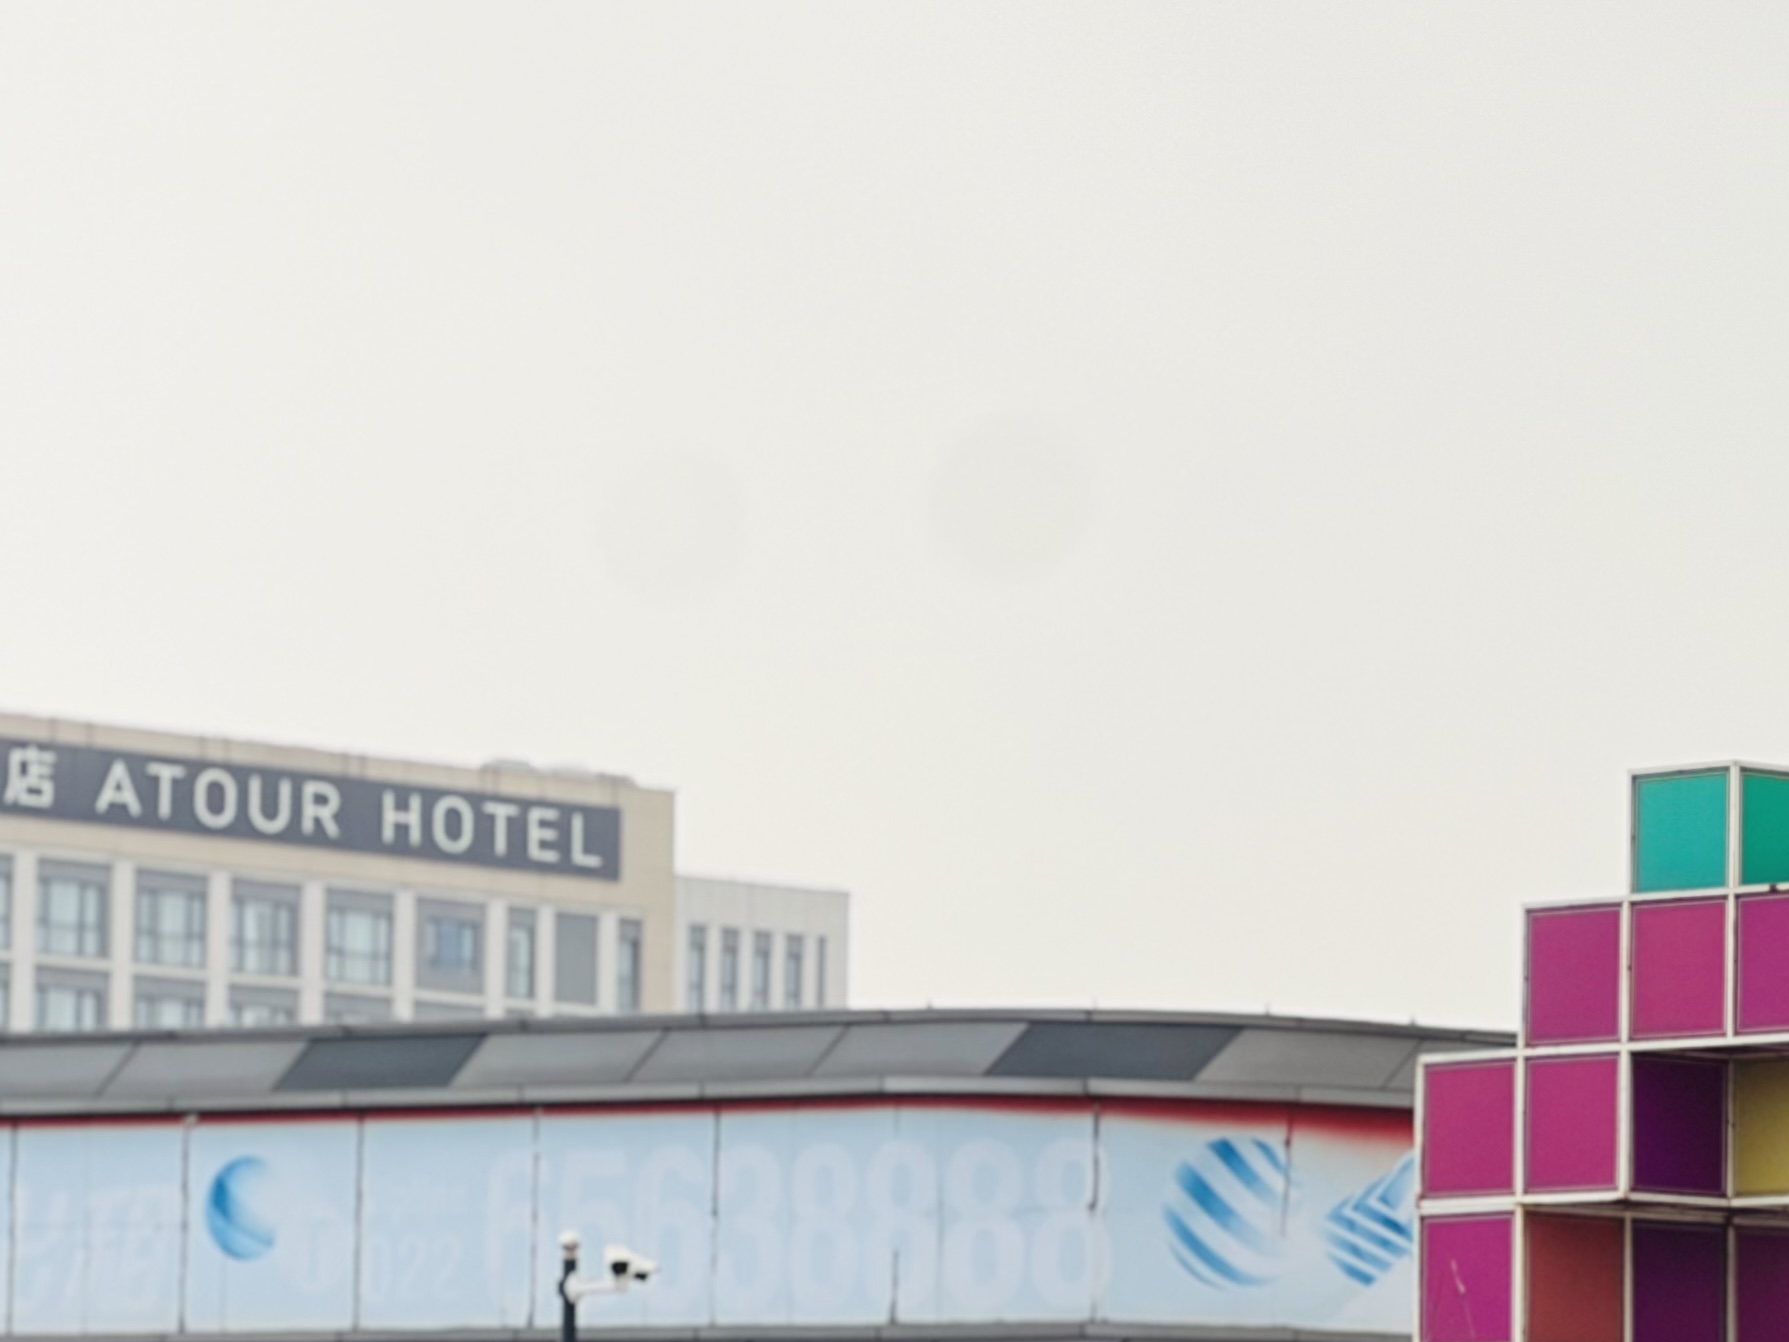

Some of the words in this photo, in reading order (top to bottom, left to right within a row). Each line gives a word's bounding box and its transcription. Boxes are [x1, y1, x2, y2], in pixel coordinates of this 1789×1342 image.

[2, 745, 58, 809] 店
[94, 760, 342, 841] ATOUR
[381, 790, 604, 868] HOTEL
